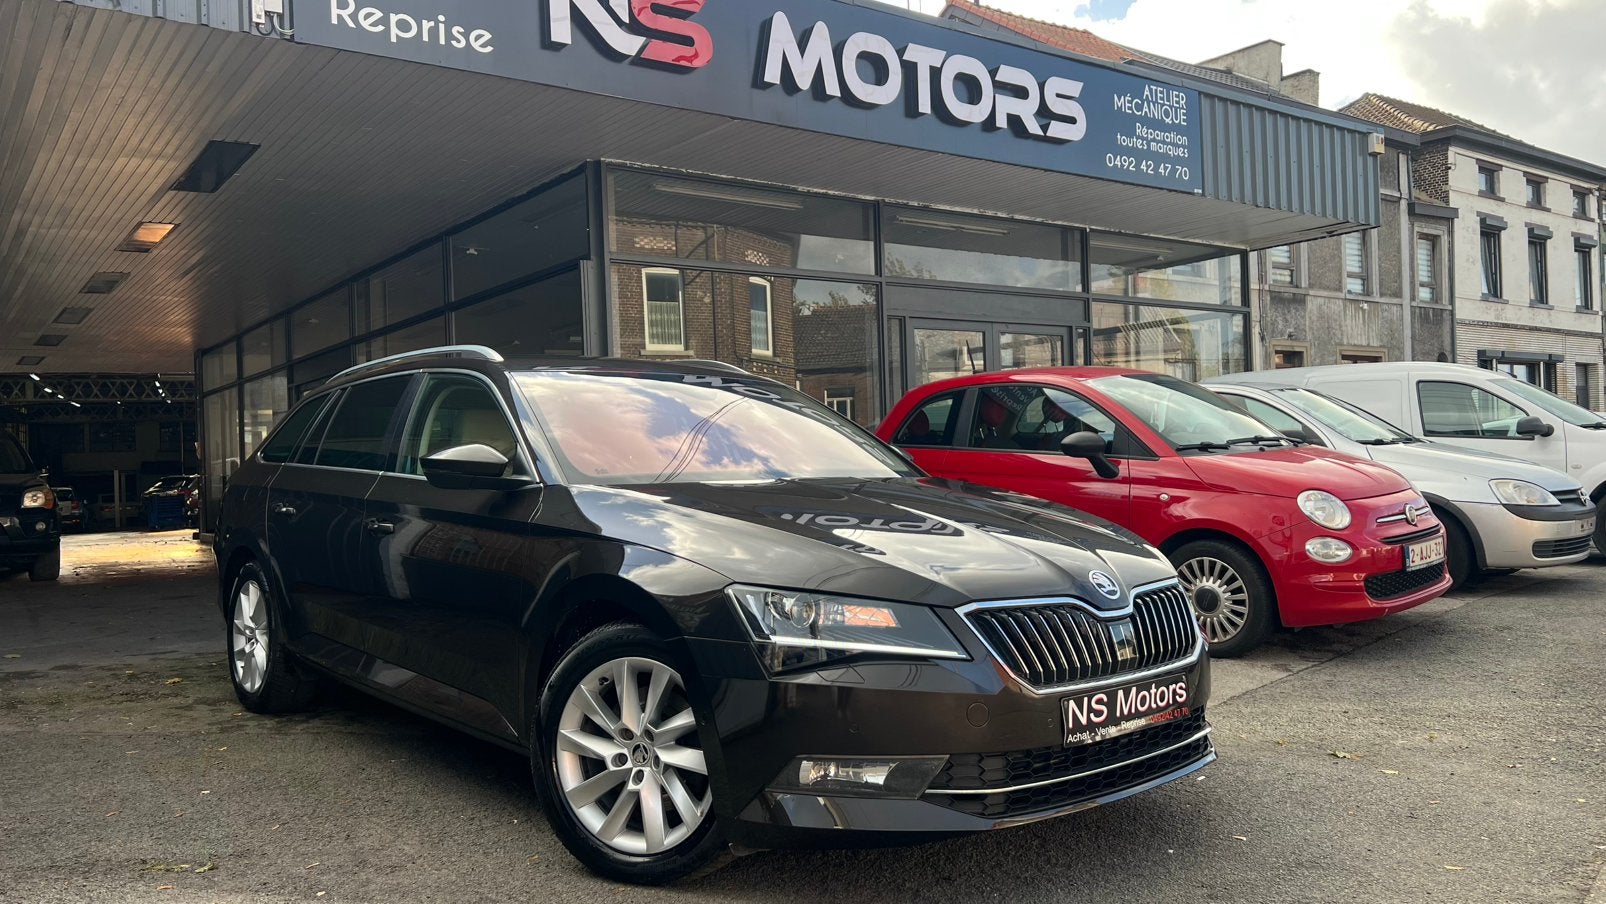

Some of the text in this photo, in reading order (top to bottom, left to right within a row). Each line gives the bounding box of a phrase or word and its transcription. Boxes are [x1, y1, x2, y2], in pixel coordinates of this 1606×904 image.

[331, 0, 494, 53] Reprise
[763, 10, 1087, 141] MOTORS
[1114, 93, 1187, 126] MÉCANIQUE
[1143, 84, 1187, 109] ATELIER
[1117, 132, 1189, 158] toutes marques
[1136, 122, 1188, 146] Réparation
[1106, 153, 1190, 180] 0492 42 47 70
[1068, 681, 1187, 729] NS Motors
[1066, 730, 1090, 743] Achat
[1121, 717, 1146, 730] Reprise
